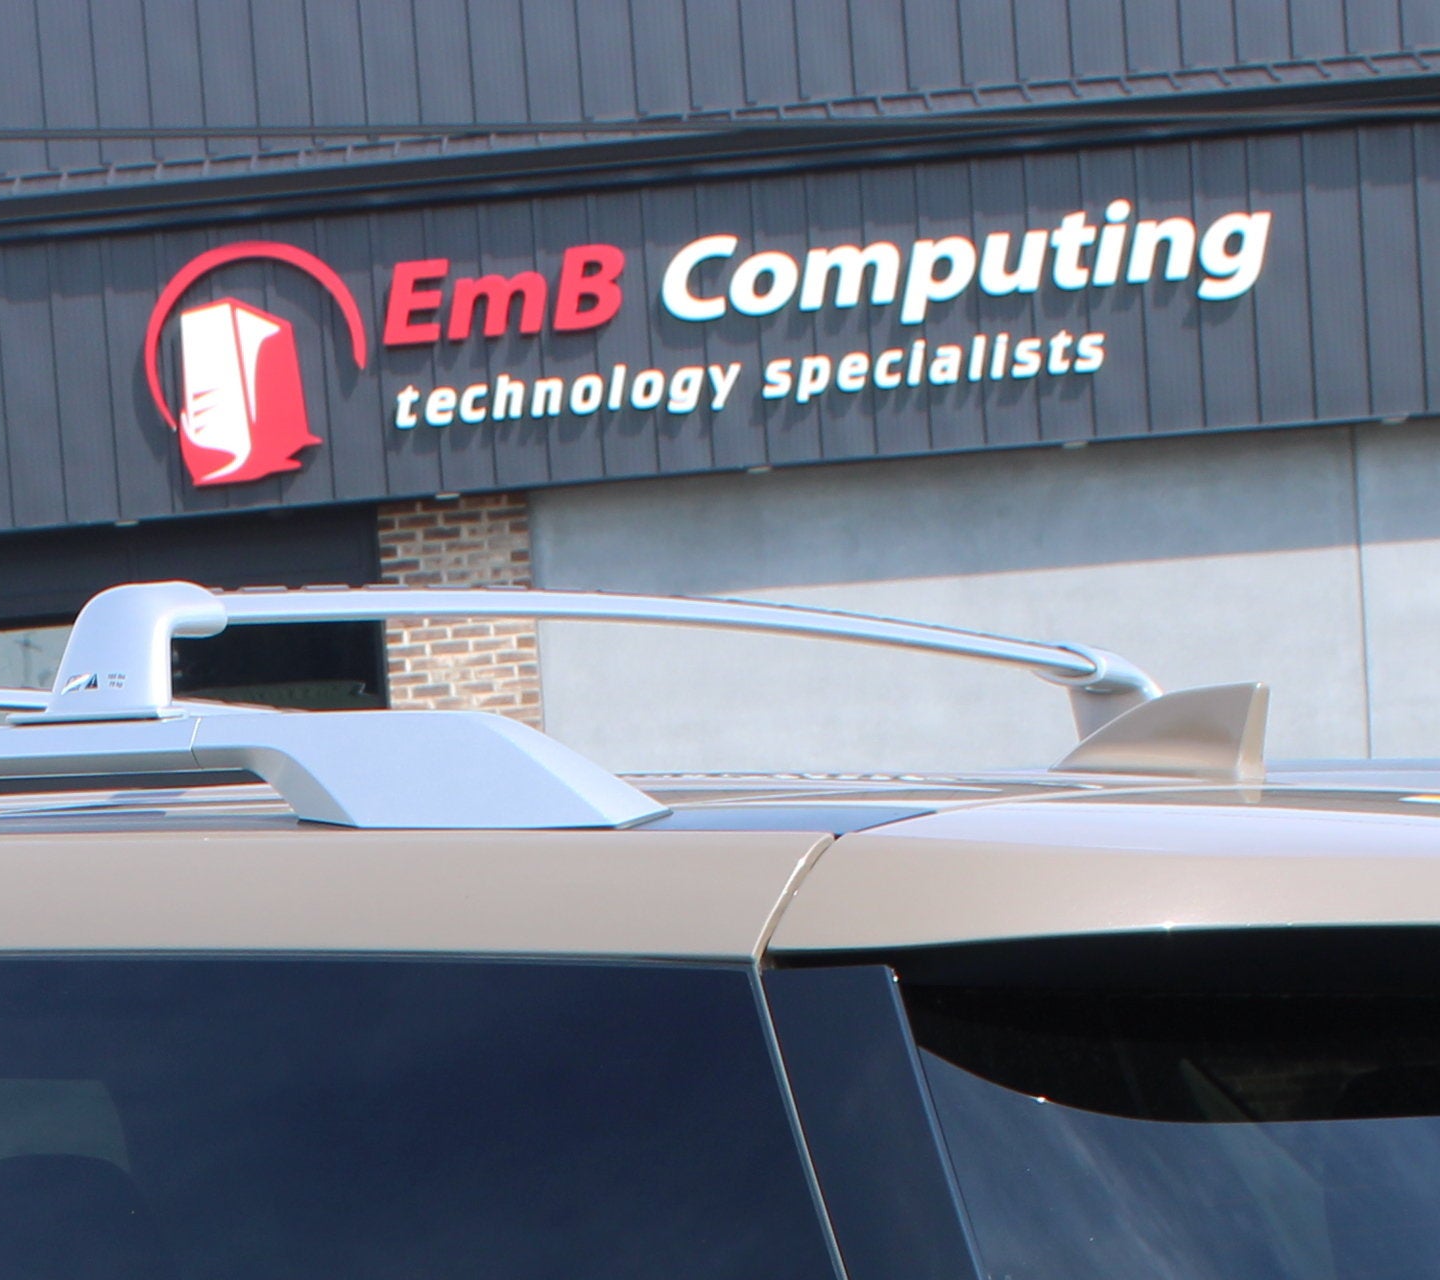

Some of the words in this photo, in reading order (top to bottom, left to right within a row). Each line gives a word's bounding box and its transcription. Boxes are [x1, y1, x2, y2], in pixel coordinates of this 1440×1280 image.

[382, 243, 627, 347] EmB
[661, 199, 1273, 325] Computing
[395, 356, 740, 429] technology
[763, 329, 1106, 400] specialists
